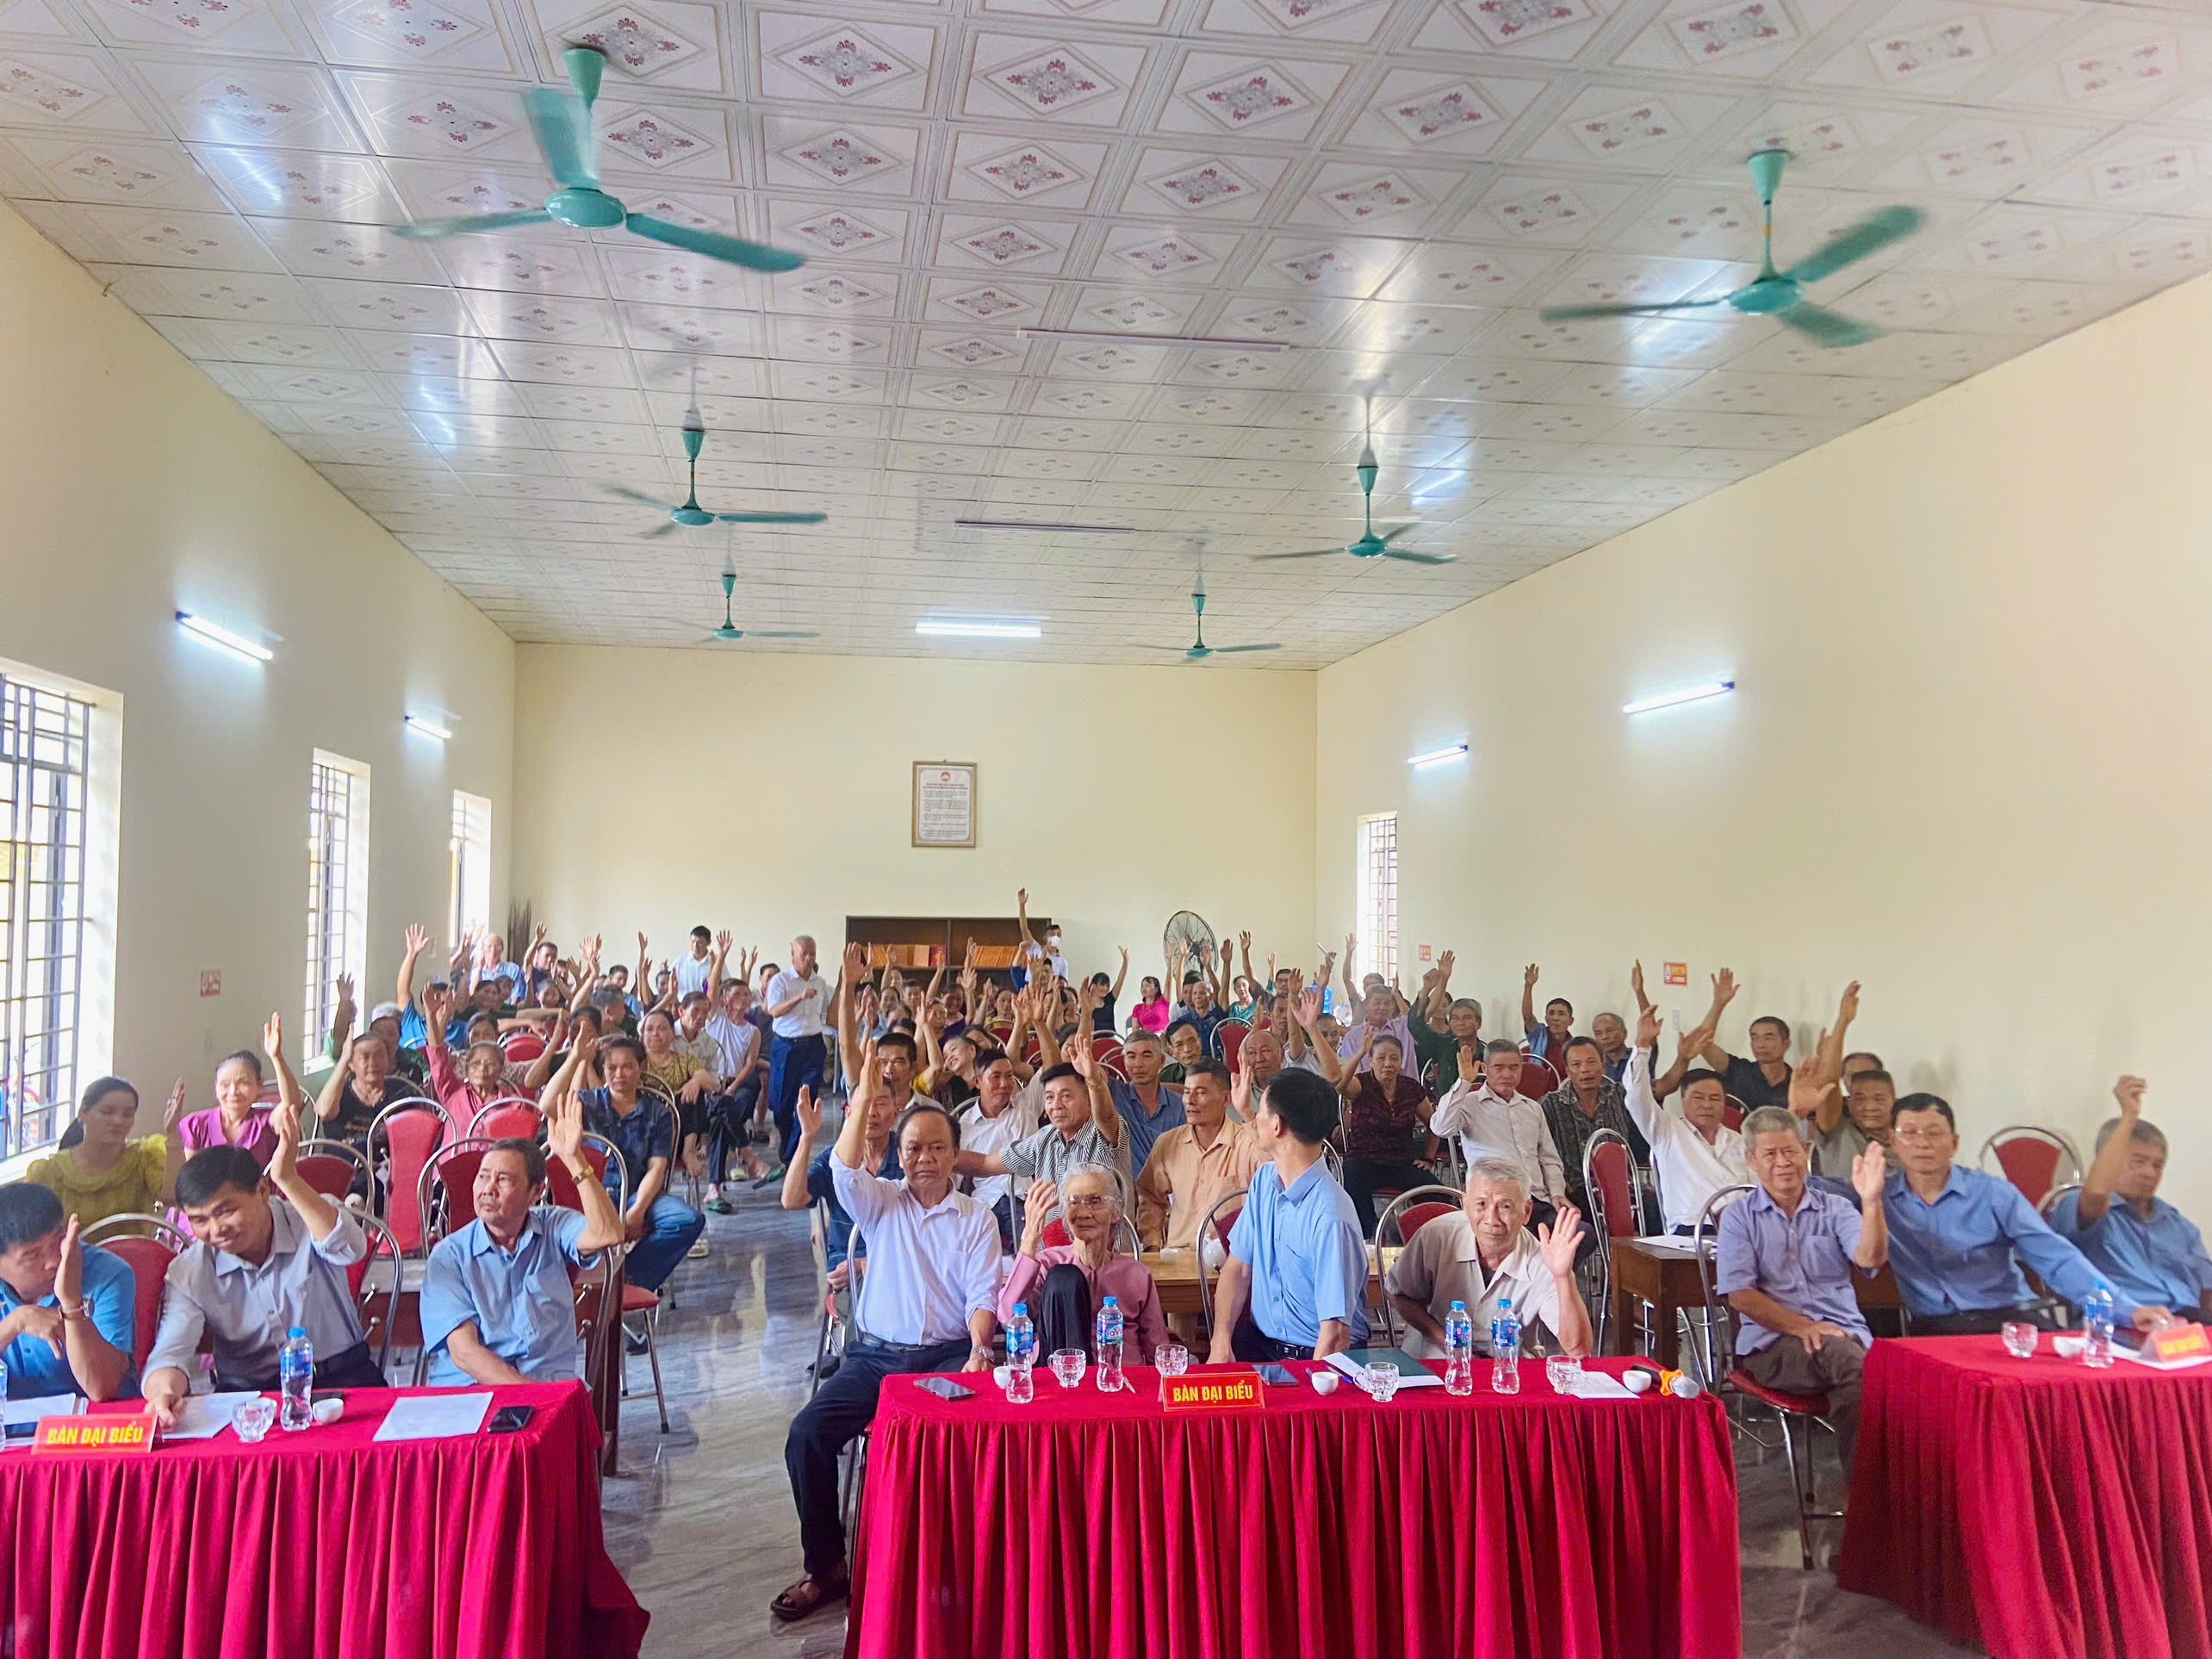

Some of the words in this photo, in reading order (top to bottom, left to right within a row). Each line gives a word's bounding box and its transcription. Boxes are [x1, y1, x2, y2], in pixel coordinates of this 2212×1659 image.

[1173, 1384, 1199, 1402] BÀN
[1202, 1385, 1222, 1404] ĐẠI
[1225, 1379, 1253, 1400] BIỂU
[47, 1425, 78, 1445] BÀN
[80, 1426, 107, 1447] ĐẠI
[109, 1420, 144, 1443] BIỂU
